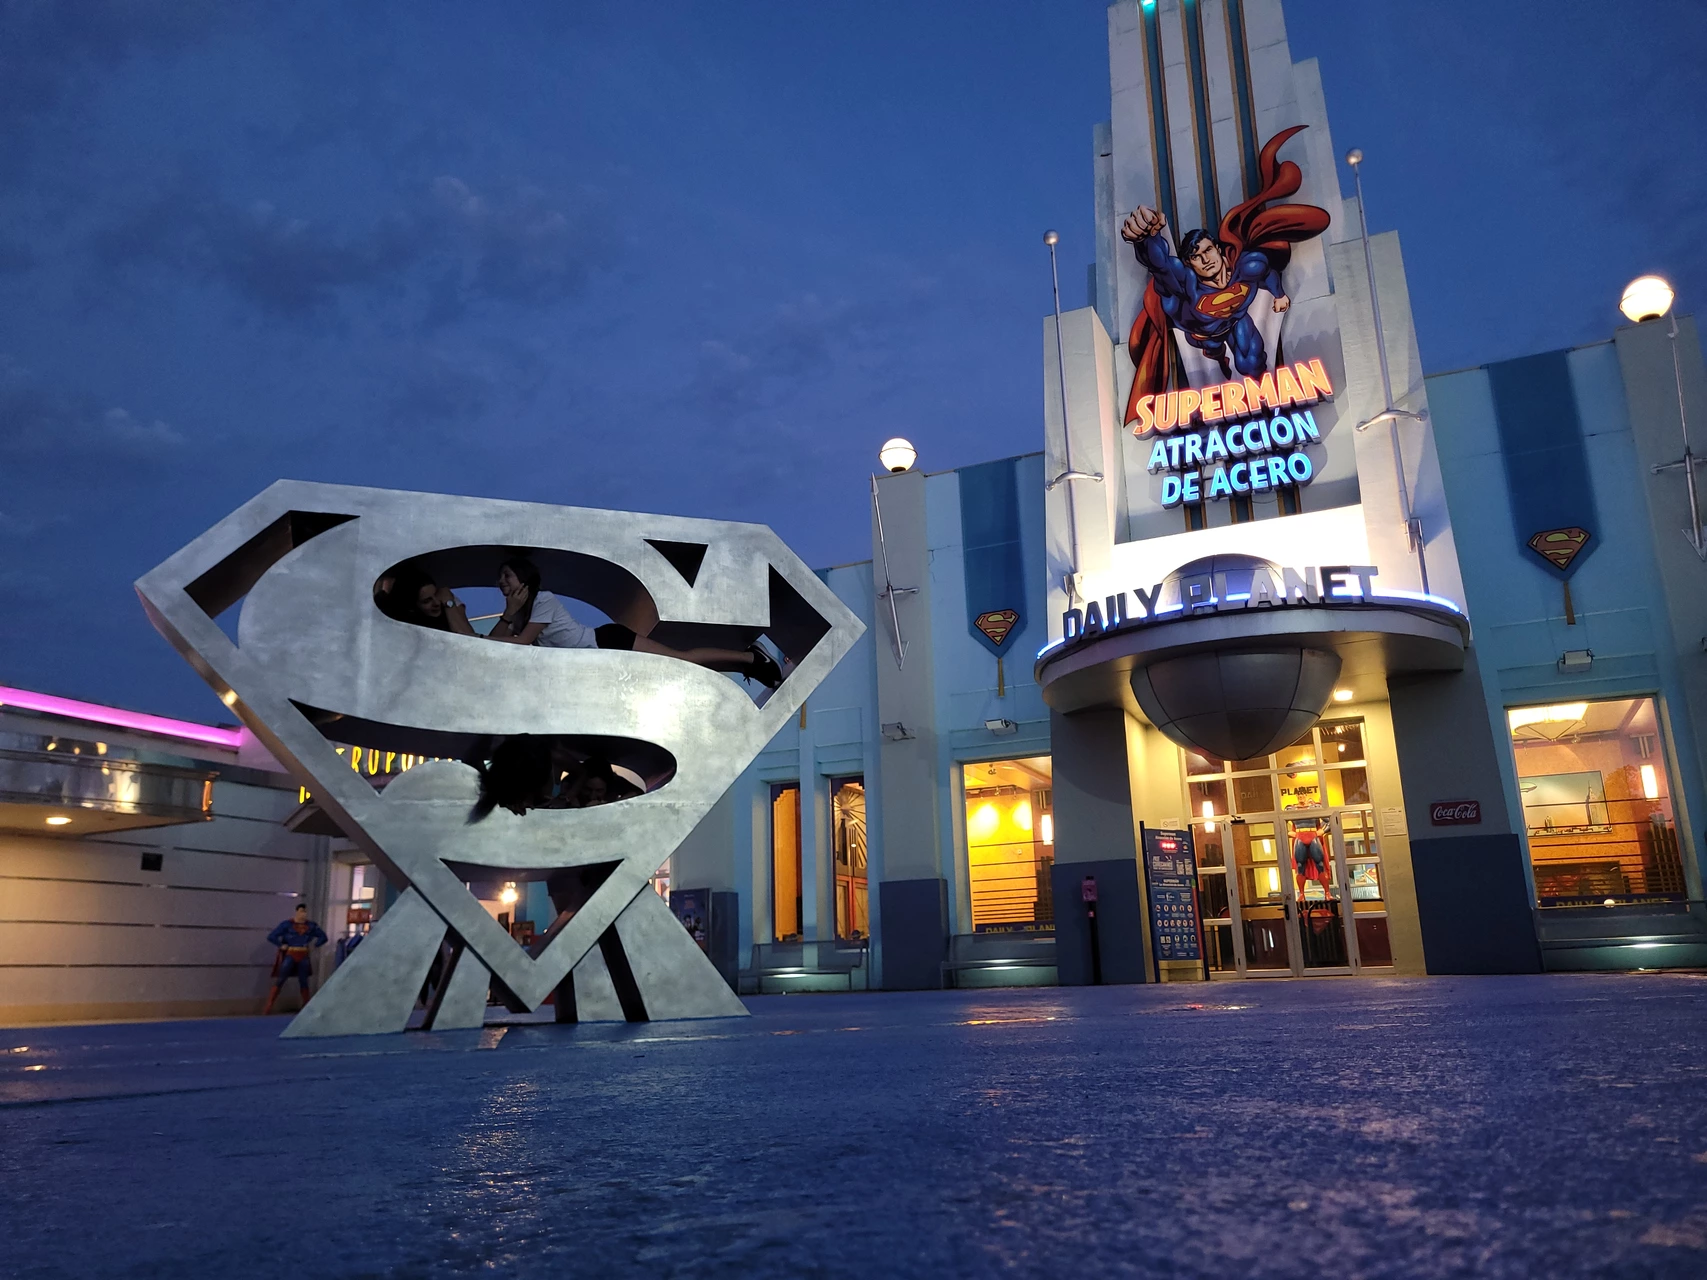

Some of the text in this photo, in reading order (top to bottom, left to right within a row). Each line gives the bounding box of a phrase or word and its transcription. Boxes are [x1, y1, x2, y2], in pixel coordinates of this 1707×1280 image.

[1132, 359, 1334, 437] SUPERMAN
[1147, 408, 1320, 471] ATRACCIÓN
[1161, 452, 1313, 508] DE ACERO
[1062, 565, 1379, 645] DAILY PLANET
